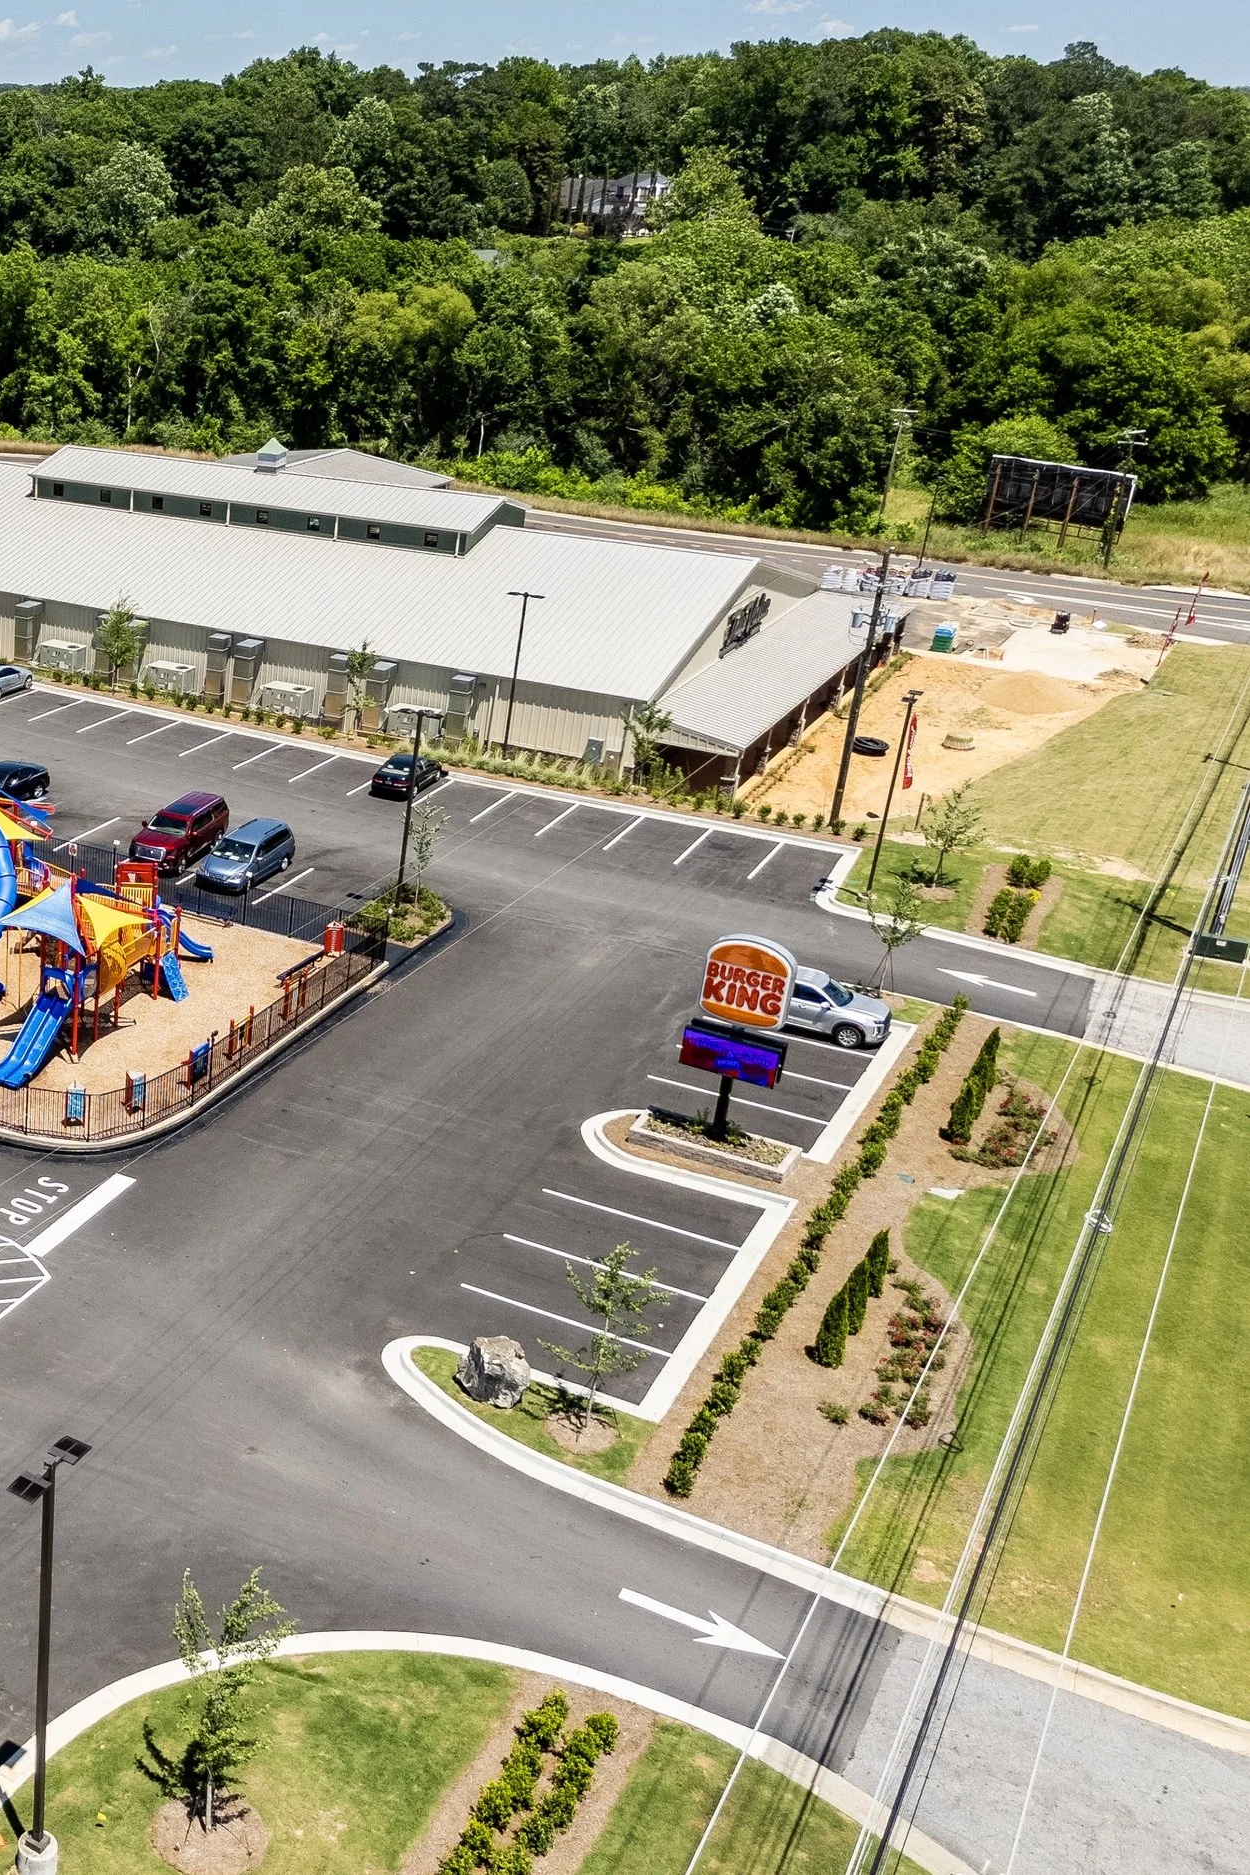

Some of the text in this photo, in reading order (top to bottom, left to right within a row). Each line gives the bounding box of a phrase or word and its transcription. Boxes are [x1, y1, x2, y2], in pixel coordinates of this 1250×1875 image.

[703, 976, 782, 1016] KING
[706, 961, 786, 995] BURGER
[0, 1176, 69, 1225] STOP
